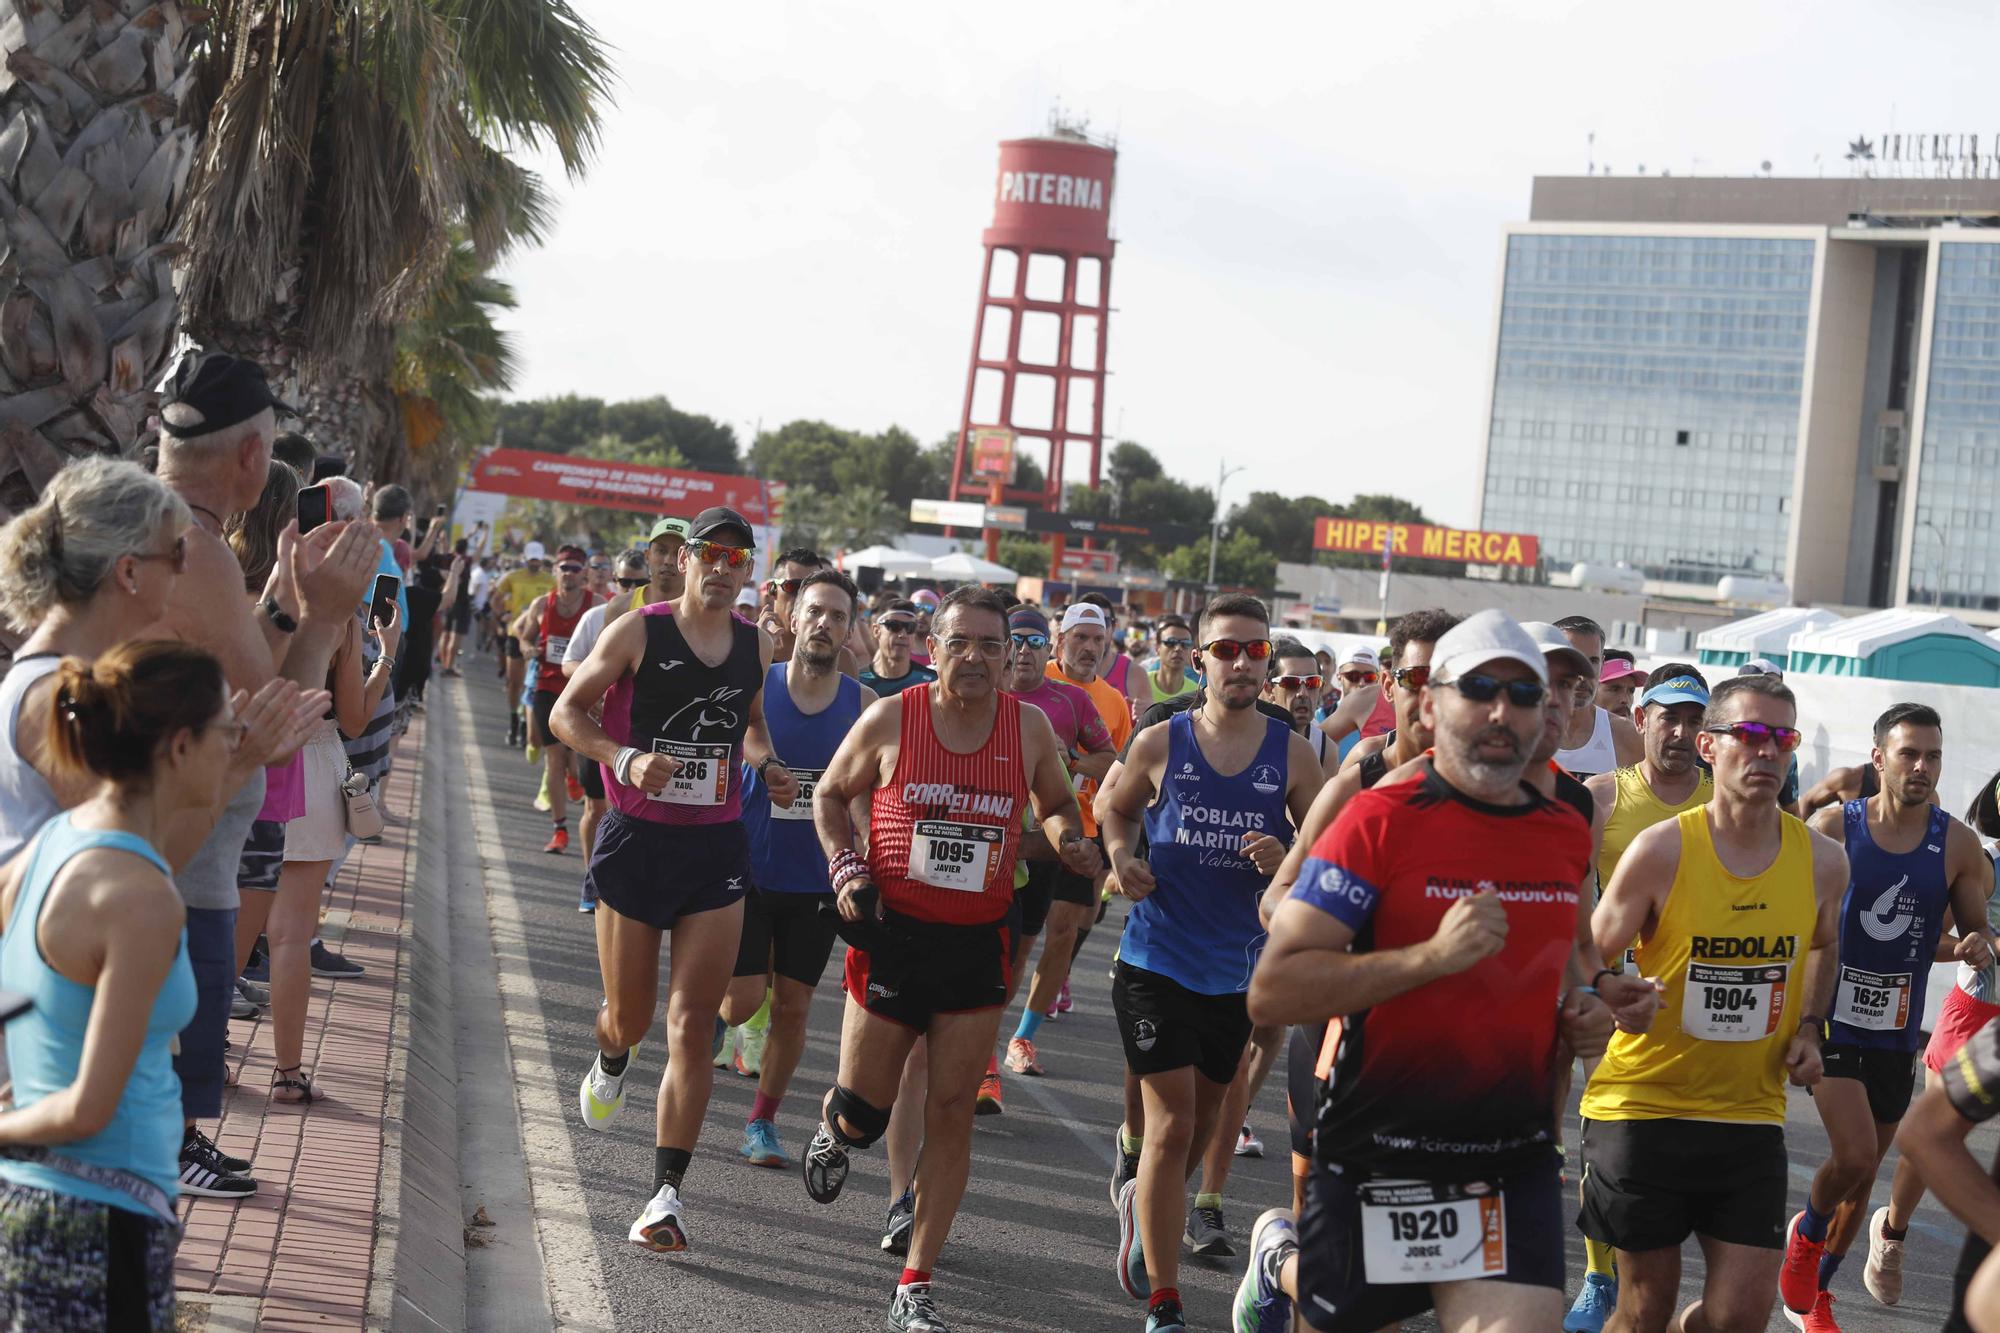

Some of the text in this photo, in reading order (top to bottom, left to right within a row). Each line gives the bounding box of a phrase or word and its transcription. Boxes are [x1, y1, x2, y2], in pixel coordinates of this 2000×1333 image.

[1001, 171, 1102, 210] PATERNA
[1326, 521, 1408, 552] HIPER
[1423, 527, 1523, 562] MERCA
[673, 761, 707, 780] 286
[1174, 773, 1200, 782] VIATOR
[674, 781, 694, 791] RAUL
[797, 784, 816, 800] 56
[795, 801, 813, 809] FRAN
[902, 782, 1014, 819] CORRELIANA
[1181, 804, 1265, 829] POBLATS
[929, 840, 975, 864] 1095
[934, 863, 962, 874] JAVIER
[1425, 875, 1474, 899] RUN
[1704, 987, 1757, 1011] 1904
[1774, 991, 1782, 1007] BOX
[1853, 986, 1891, 1008] 1625
[1711, 1013, 1743, 1024] RAMON
[1851, 1005, 1885, 1017] BERNARDO
[1388, 1208, 1459, 1242] 1920
[1405, 1245, 1443, 1259] JORGE
